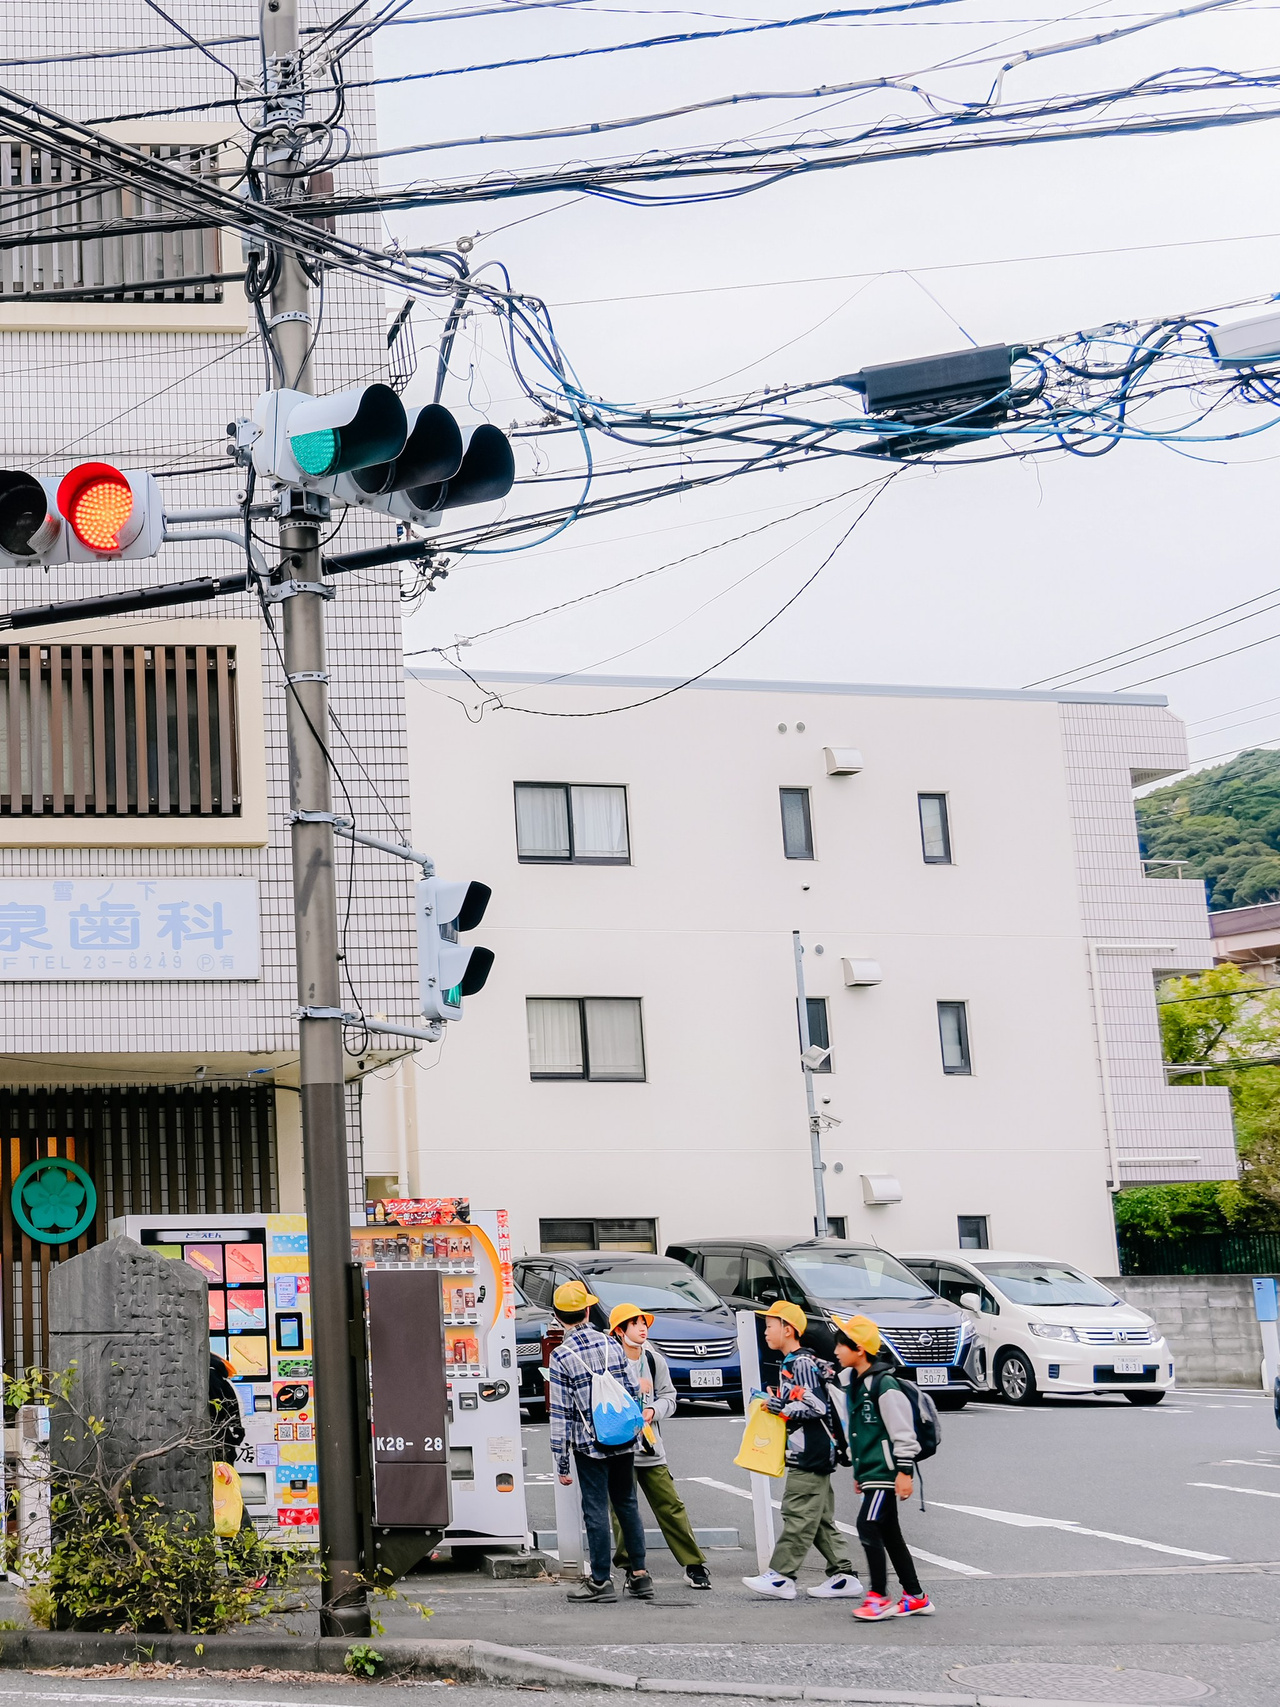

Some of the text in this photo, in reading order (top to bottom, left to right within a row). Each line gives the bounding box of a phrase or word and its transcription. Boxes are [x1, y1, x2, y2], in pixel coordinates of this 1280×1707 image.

[52, 880, 157, 902] 雪ノ下
[28, 955, 71, 969] TEL
[83, 954, 183, 970] 23-8249
[385, 1200, 448, 1212] モンスターハンター
[697, 1376, 721, 1386] 24-19
[923, 1374, 947, 1384] 50-72
[376, 1436, 443, 1451] K28- 28
[235, 1442, 255, 1464] 店
